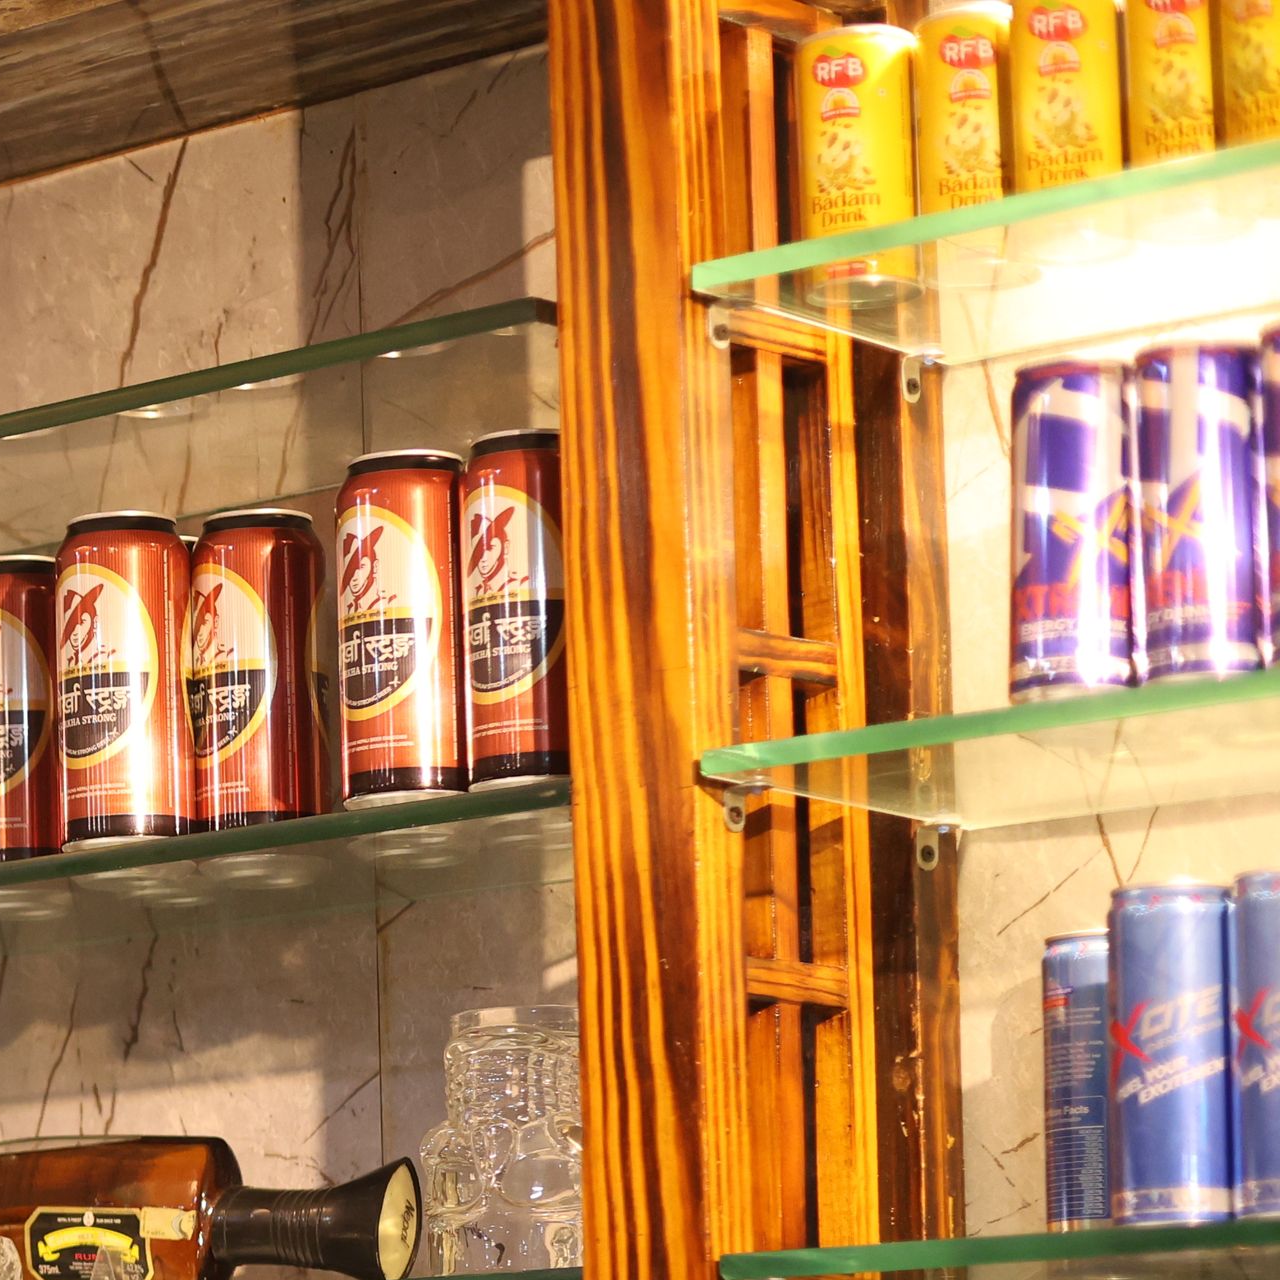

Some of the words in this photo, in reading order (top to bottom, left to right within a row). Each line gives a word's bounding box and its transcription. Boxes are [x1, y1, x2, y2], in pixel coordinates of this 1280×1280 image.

[1032, 8, 1085, 36] RFB
[944, 38, 994, 62] RFB
[816, 57, 864, 82] RFB
[1027, 148, 1104, 172] Badam
[939, 174, 1010, 197] Badam
[1040, 166, 1089, 184] Drink
[812, 190, 881, 216] Badam
[821, 207, 867, 228] Drink
[492, 644, 532, 657] STRONG
[362, 661, 398, 675] STRONG
[82, 712, 117, 725] STRONG
[1063, 1105, 1090, 1116] Facts
[400, 1198, 417, 1249] Nepal
[74, 1252, 104, 1262] RUM
